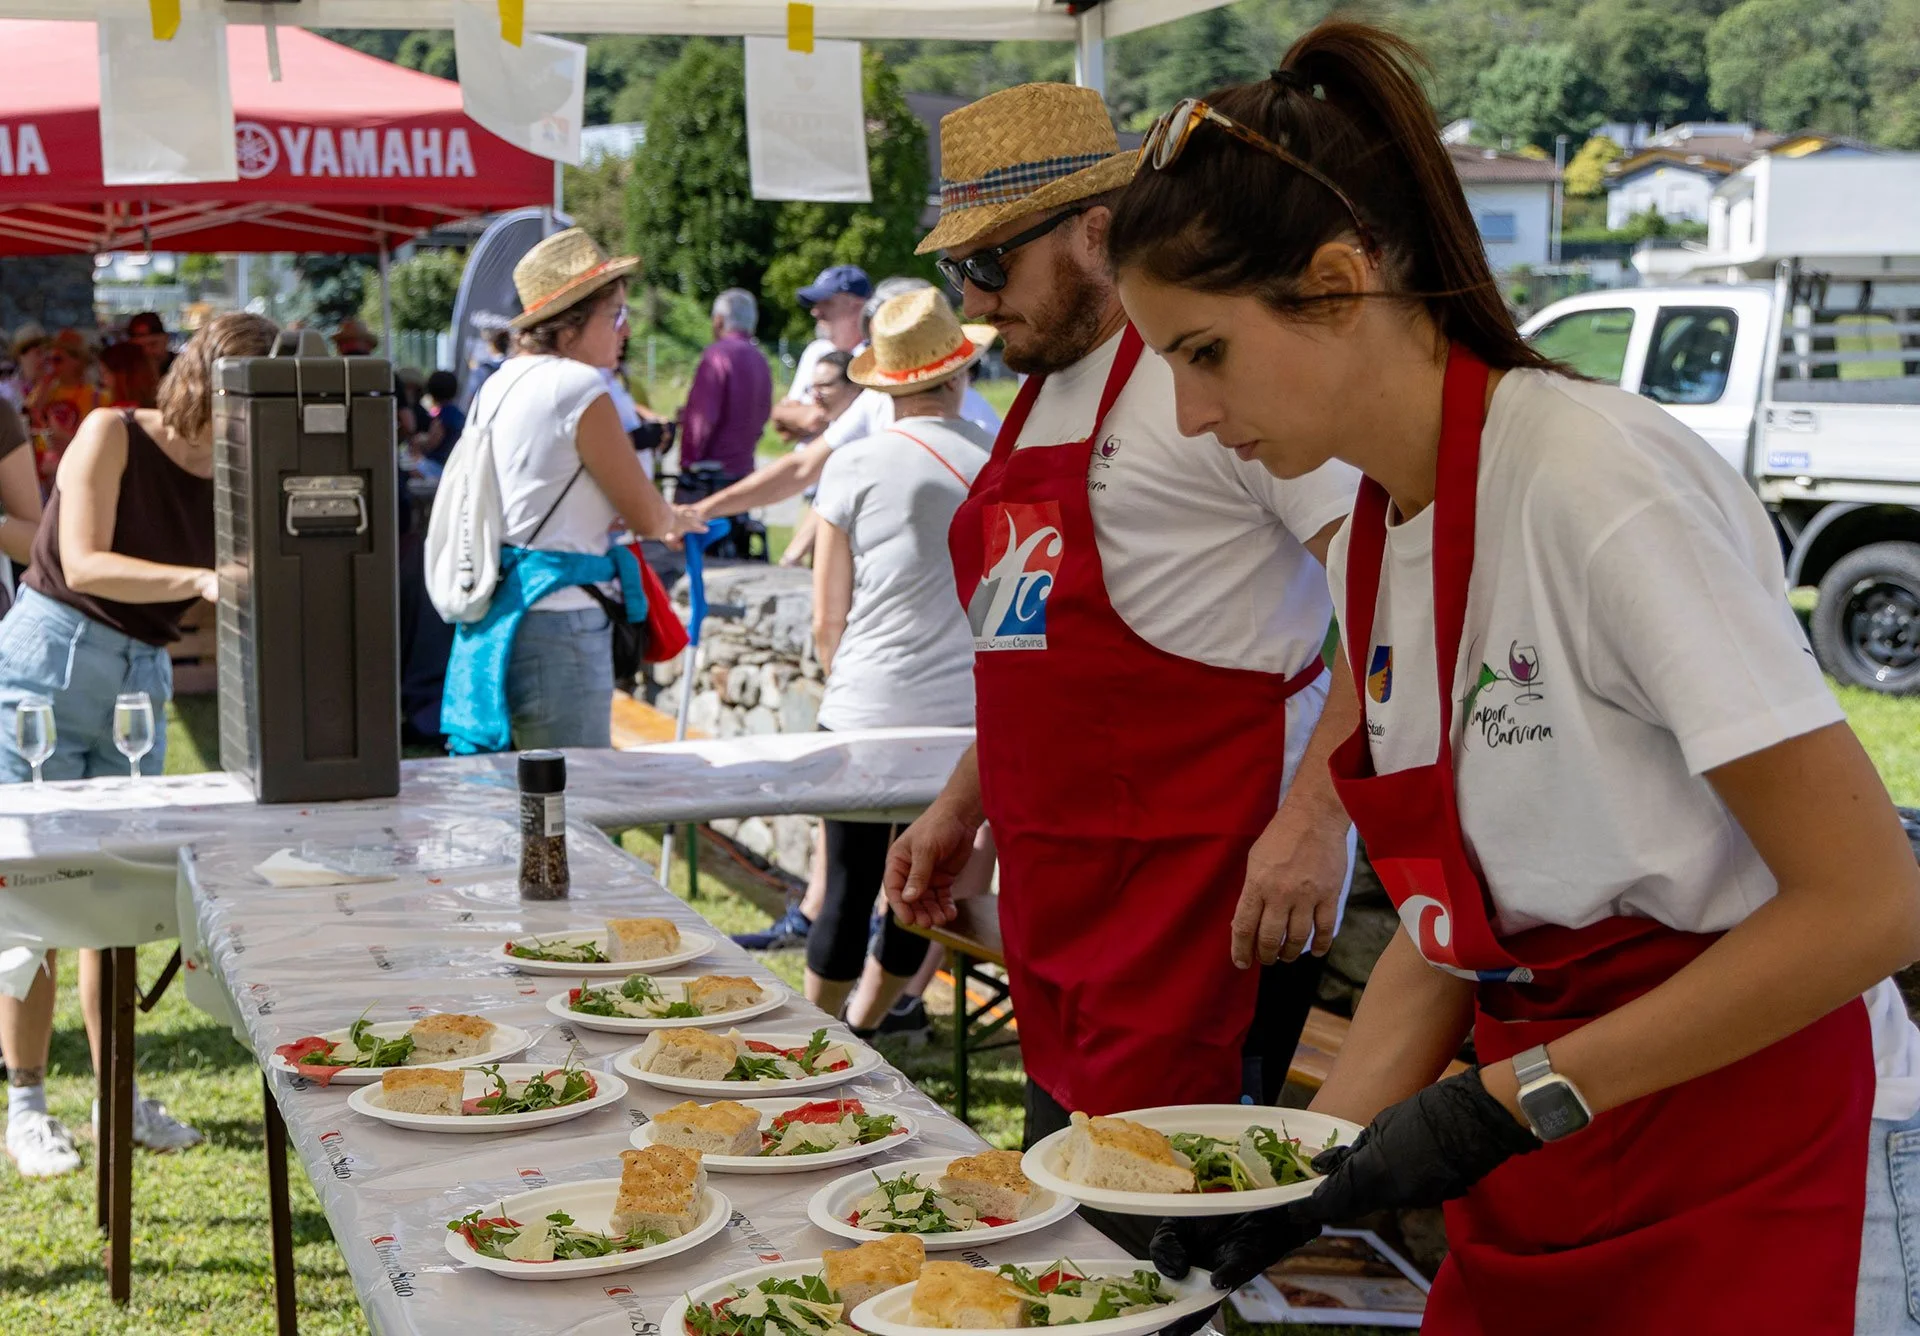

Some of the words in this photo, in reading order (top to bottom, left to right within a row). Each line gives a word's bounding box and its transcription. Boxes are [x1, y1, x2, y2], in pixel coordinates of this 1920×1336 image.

[0, 124, 51, 176] A
[279, 127, 477, 178] YAMAHA
[1013, 635, 1044, 649] Carvina
[1487, 722, 1553, 748] Carvina
